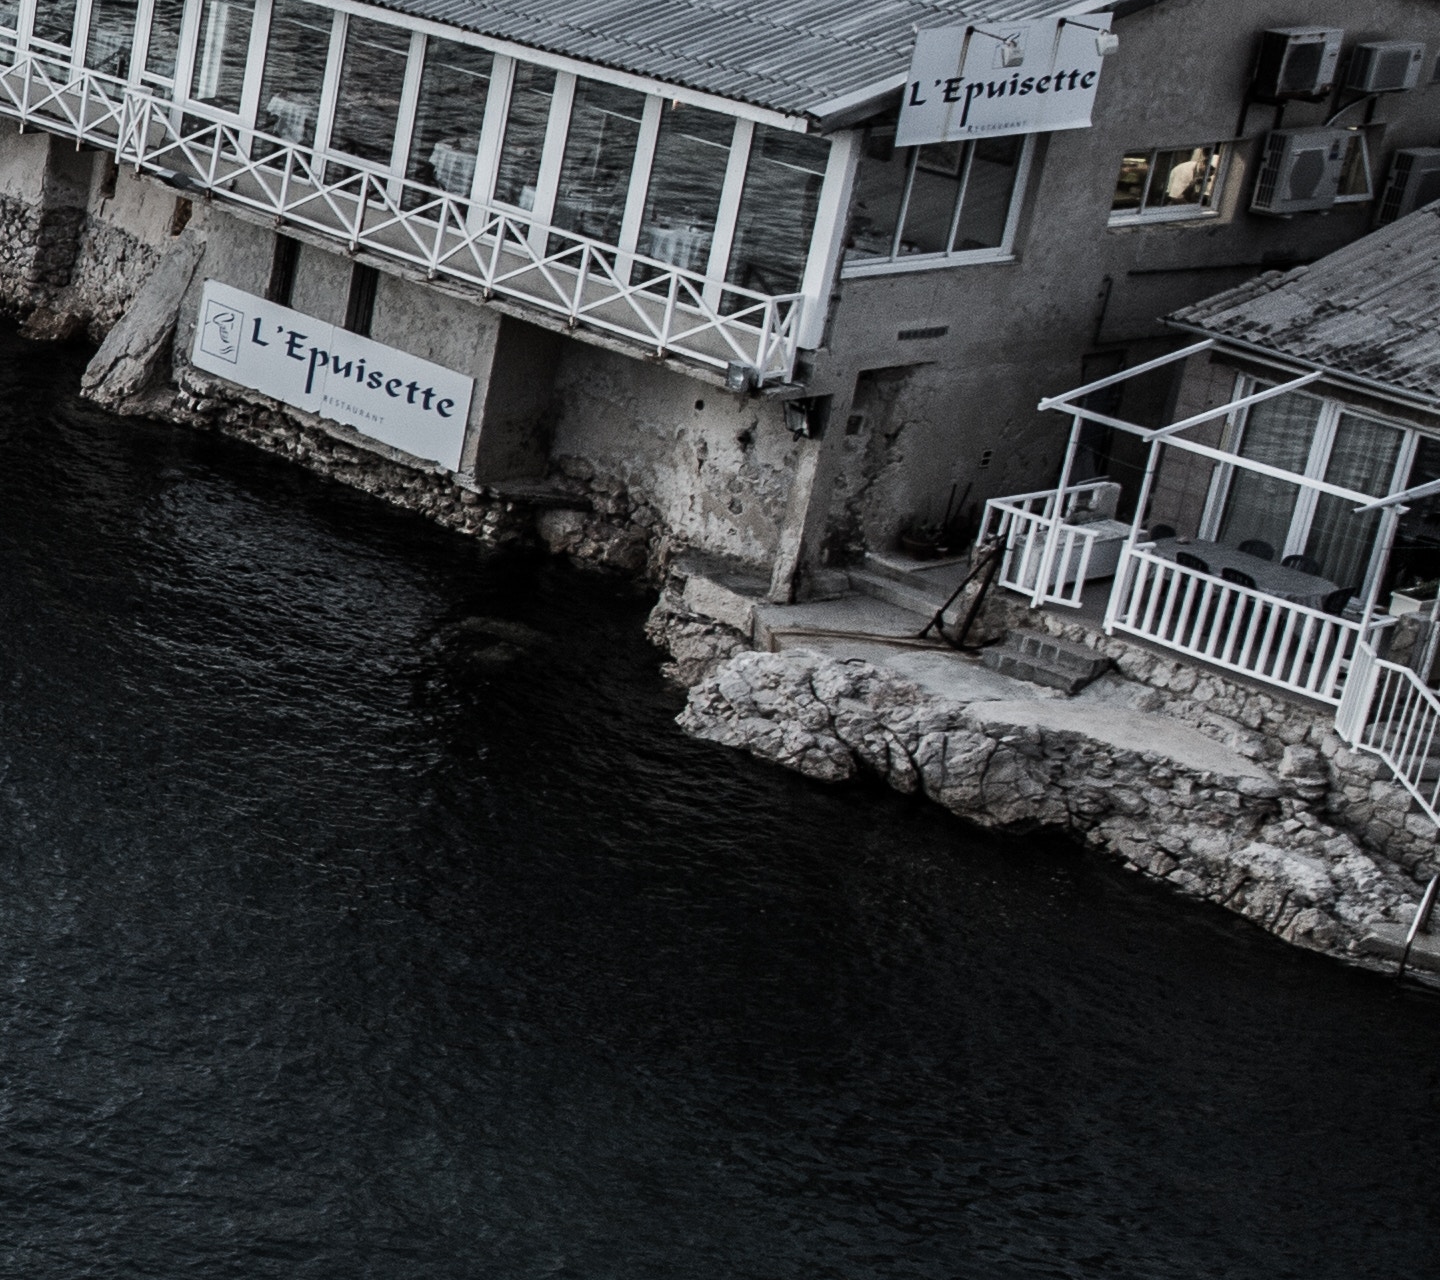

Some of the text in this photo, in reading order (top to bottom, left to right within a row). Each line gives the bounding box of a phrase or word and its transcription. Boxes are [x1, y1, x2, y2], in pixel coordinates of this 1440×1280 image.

[909, 69, 1097, 128] L'Epuisette
[251, 316, 456, 418] L'Epuisette
[322, 394, 384, 424] RESTAURANT
